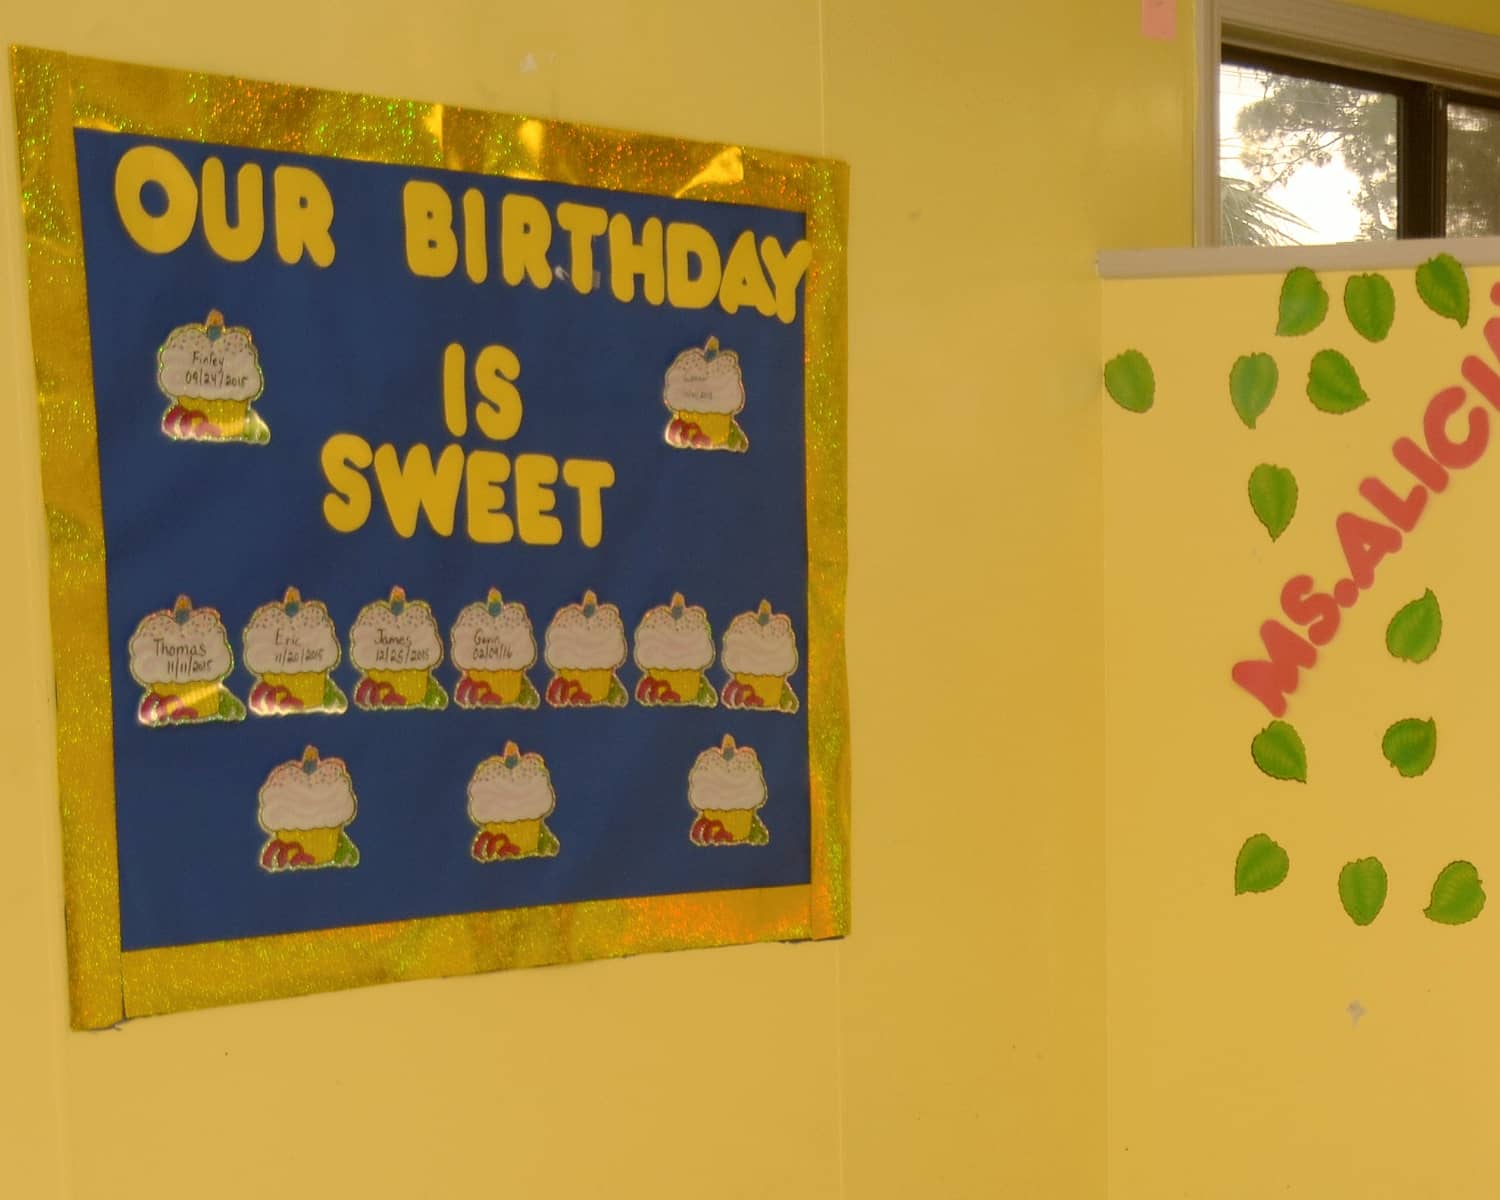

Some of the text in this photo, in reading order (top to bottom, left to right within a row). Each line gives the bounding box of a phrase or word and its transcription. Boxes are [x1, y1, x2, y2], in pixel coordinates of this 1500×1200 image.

[113, 145, 812, 325] OUR BIRTHDAY
[191, 351, 225, 374] Finley
[442, 342, 524, 441] IS
[321, 433, 615, 548] SWEET
[153, 638, 207, 657] Thomas
[374, 628, 413, 648] James
[167, 656, 214, 680] 11/11/2015
